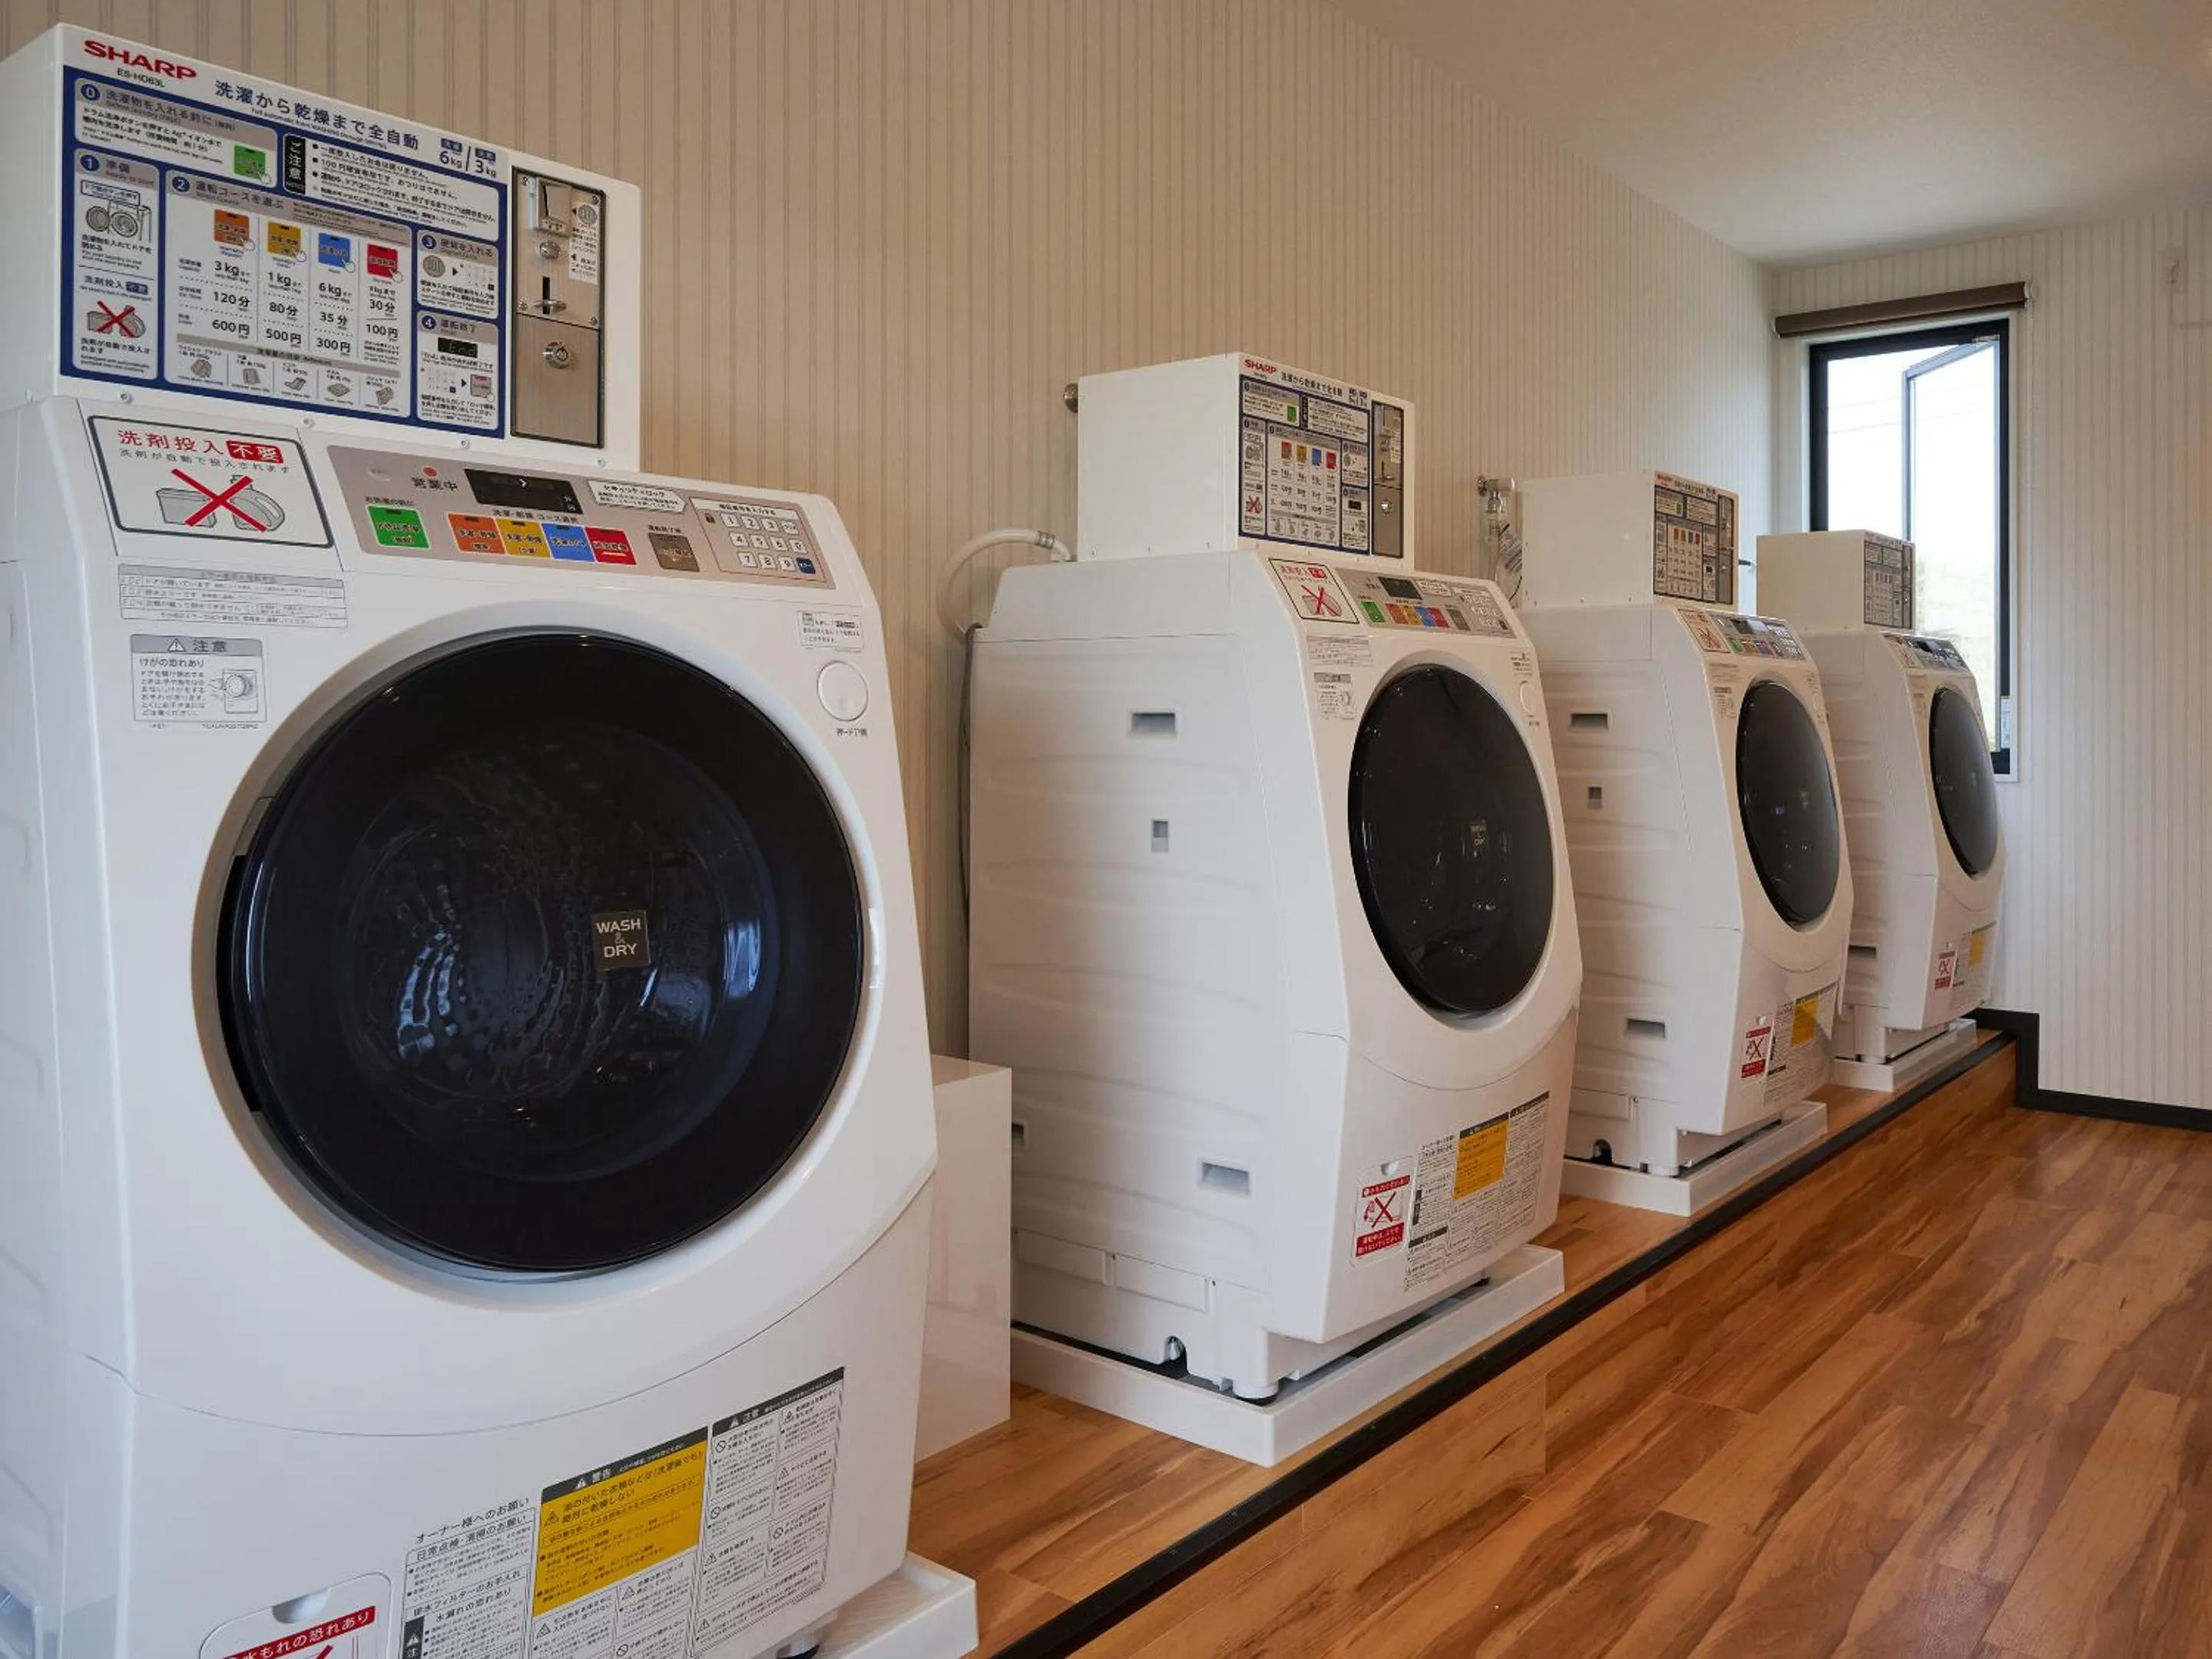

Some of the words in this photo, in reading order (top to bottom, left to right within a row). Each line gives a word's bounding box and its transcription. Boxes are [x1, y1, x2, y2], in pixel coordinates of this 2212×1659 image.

[84, 40, 197, 80] SHARP
[215, 80, 419, 150] 洗濯から乾燥まで全自動
[213, 291, 250, 307] 120分
[369, 299, 396, 313] 30分
[269, 302, 298, 316] 80分
[320, 311, 348, 326] 35分
[212, 319, 250, 336] 600円
[366, 323, 399, 339] 100円
[266, 328, 302, 345] 500円
[316, 336, 351, 354] 300円
[1244, 359, 1277, 374] SHARP
[118, 429, 224, 455] 洗剤投入
[233, 443, 280, 462] 不要
[120, 449, 290, 473] 洗剤が自動で投入されます
[412, 475, 459, 492] 営業中
[193, 639, 227, 653] 注意
[140, 657, 205, 668] けがの恐れあり
[595, 918, 641, 934] WASH
[614, 932, 626, 944] &
[603, 943, 638, 958] DRY
[416, 1497, 530, 1544] オーナー様へのお願い
